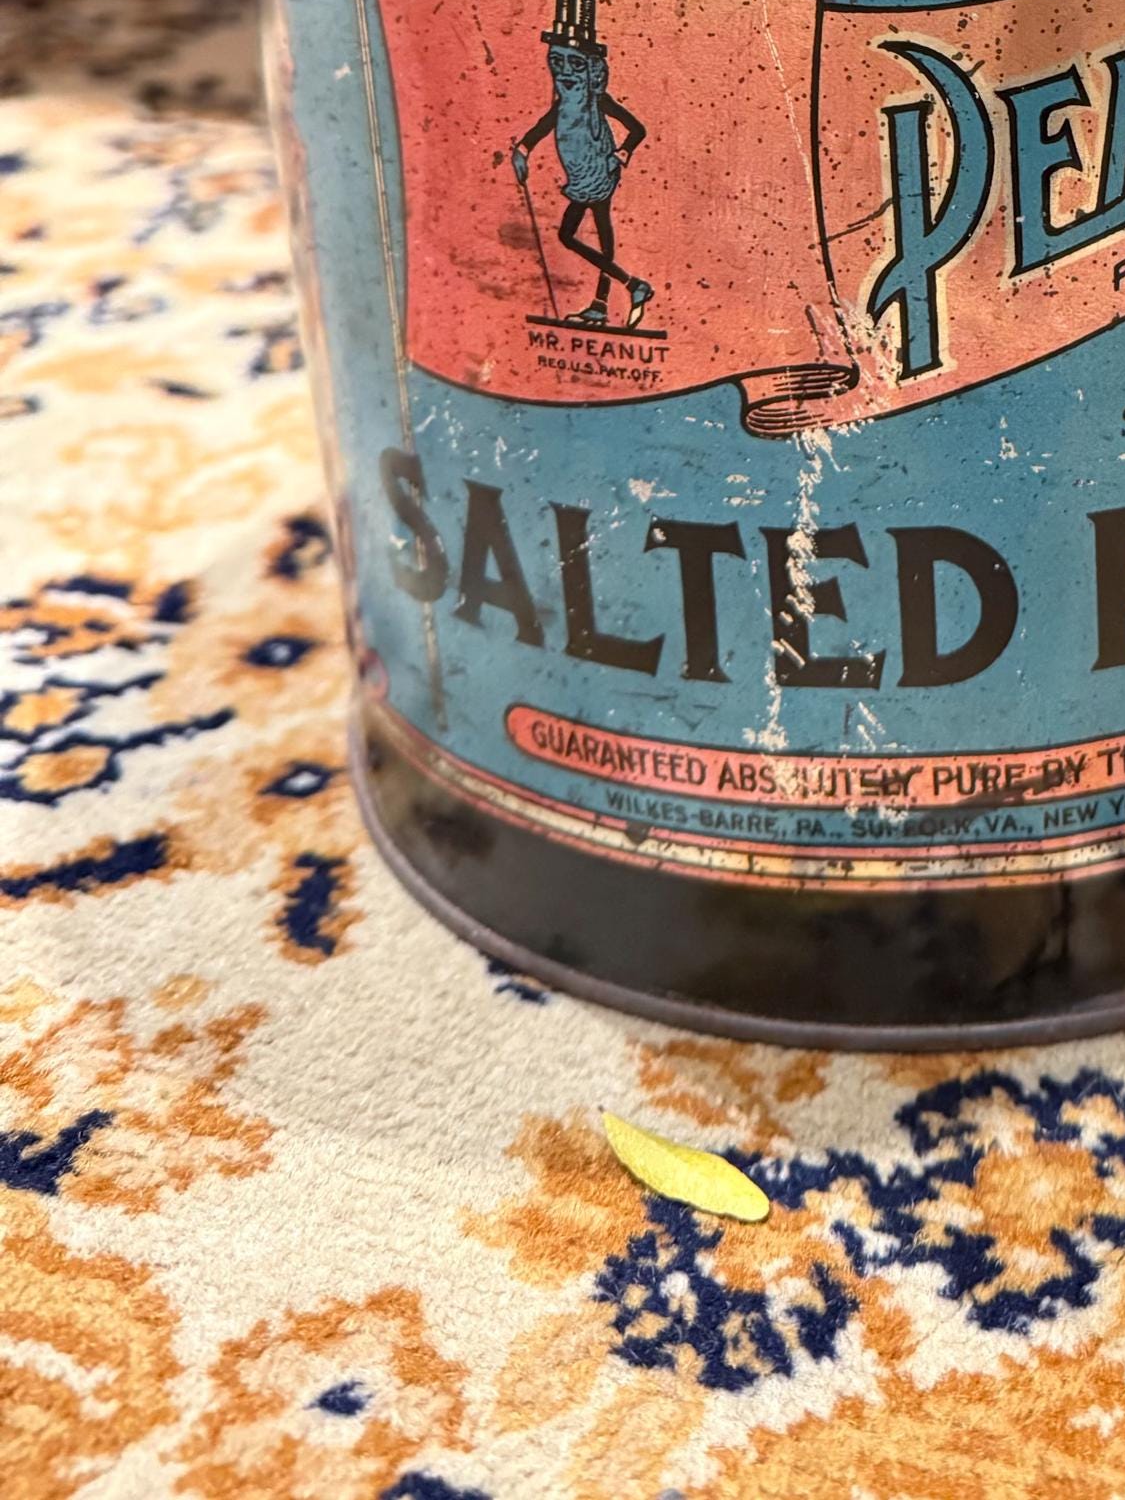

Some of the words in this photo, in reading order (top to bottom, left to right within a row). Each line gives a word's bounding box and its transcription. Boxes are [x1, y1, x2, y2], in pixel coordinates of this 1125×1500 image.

[528, 331, 565, 351] MR.
[571, 337, 670, 363] PEANUT
[379, 447, 1019, 690] SALTED
[531, 721, 707, 786] GUARANTEED
[718, 758, 924, 797] ABSLUTELY
[933, 763, 1026, 796] PURE
[1041, 753, 1087, 794] BY
[1043, 804, 1107, 829] NEW
